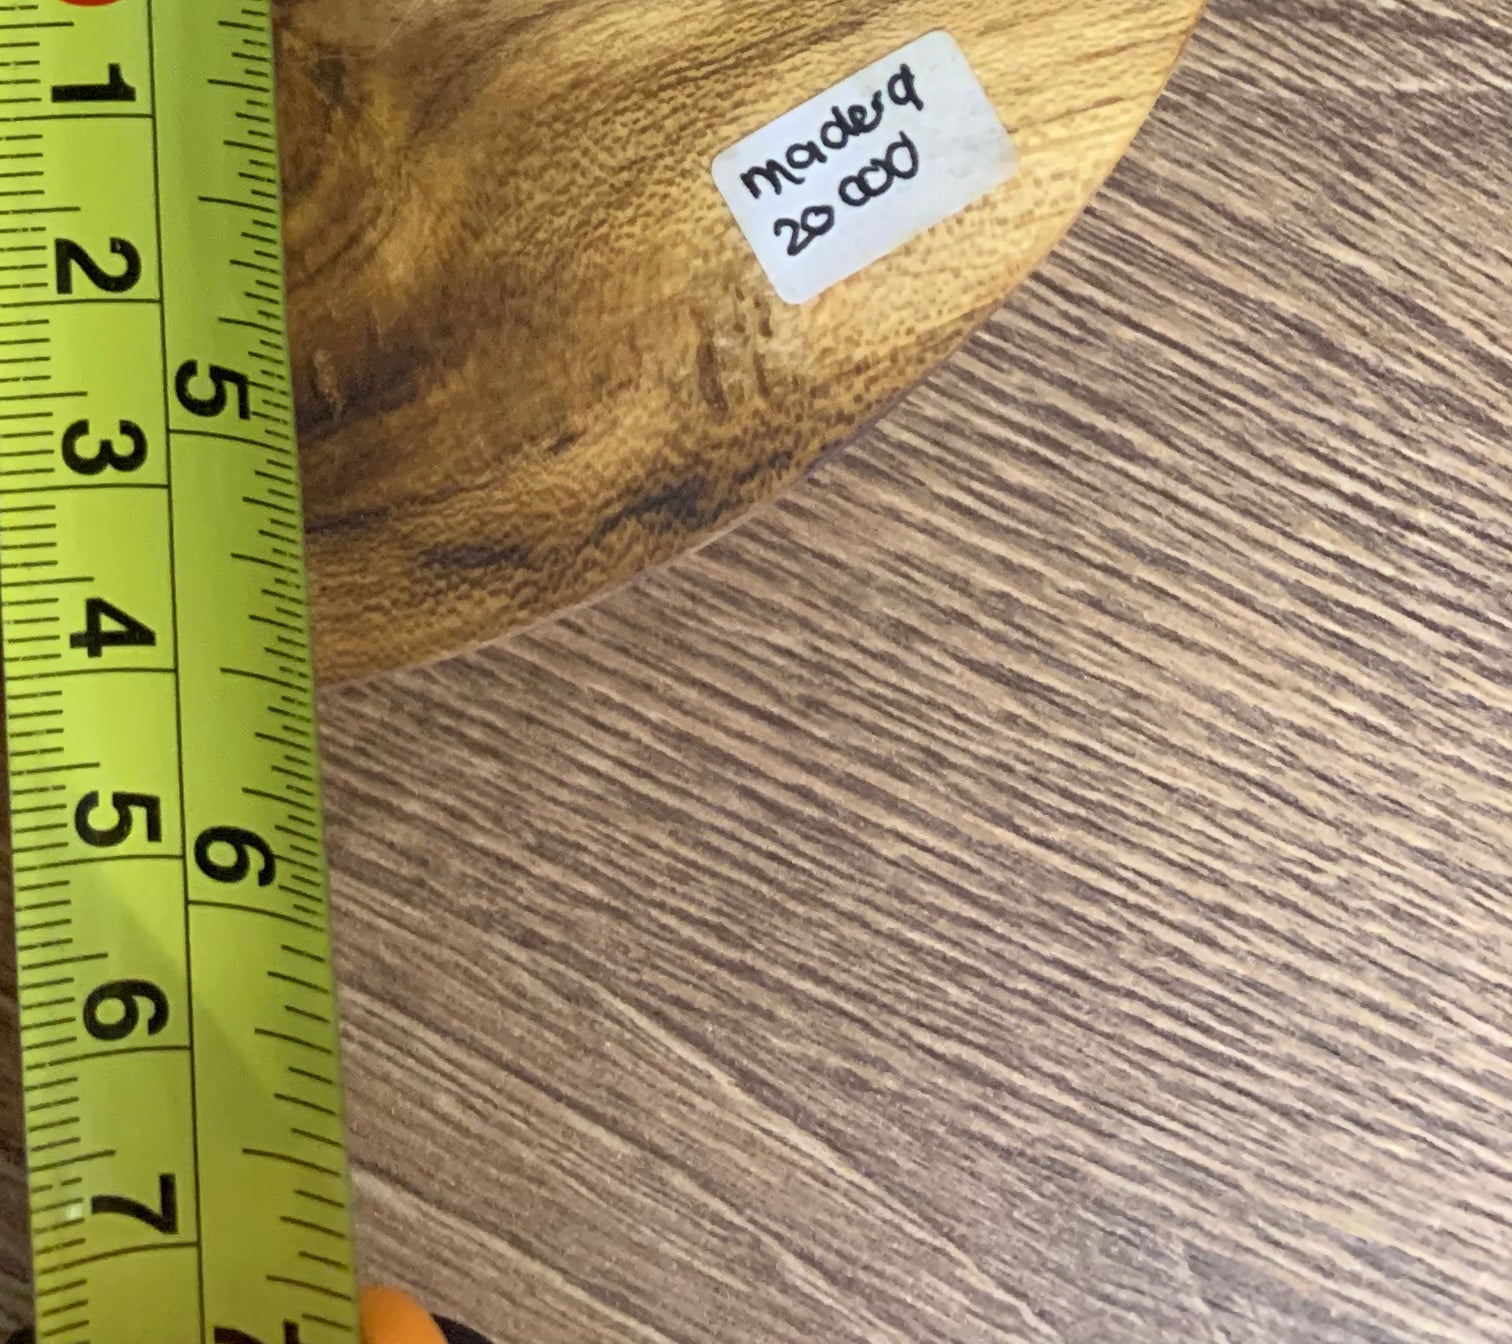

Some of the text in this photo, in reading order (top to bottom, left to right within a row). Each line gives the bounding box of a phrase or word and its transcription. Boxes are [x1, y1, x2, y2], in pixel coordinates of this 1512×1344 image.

[50, 63, 137, 103] 1
[54, 237, 142, 295] 2
[174, 359, 251, 420] 5
[61, 419, 148, 475] 3
[69, 597, 157, 658] 4
[74, 790, 162, 847] 5
[194, 825, 276, 887] 6
[83, 979, 169, 1041] 6
[91, 1173, 178, 1234] 7
